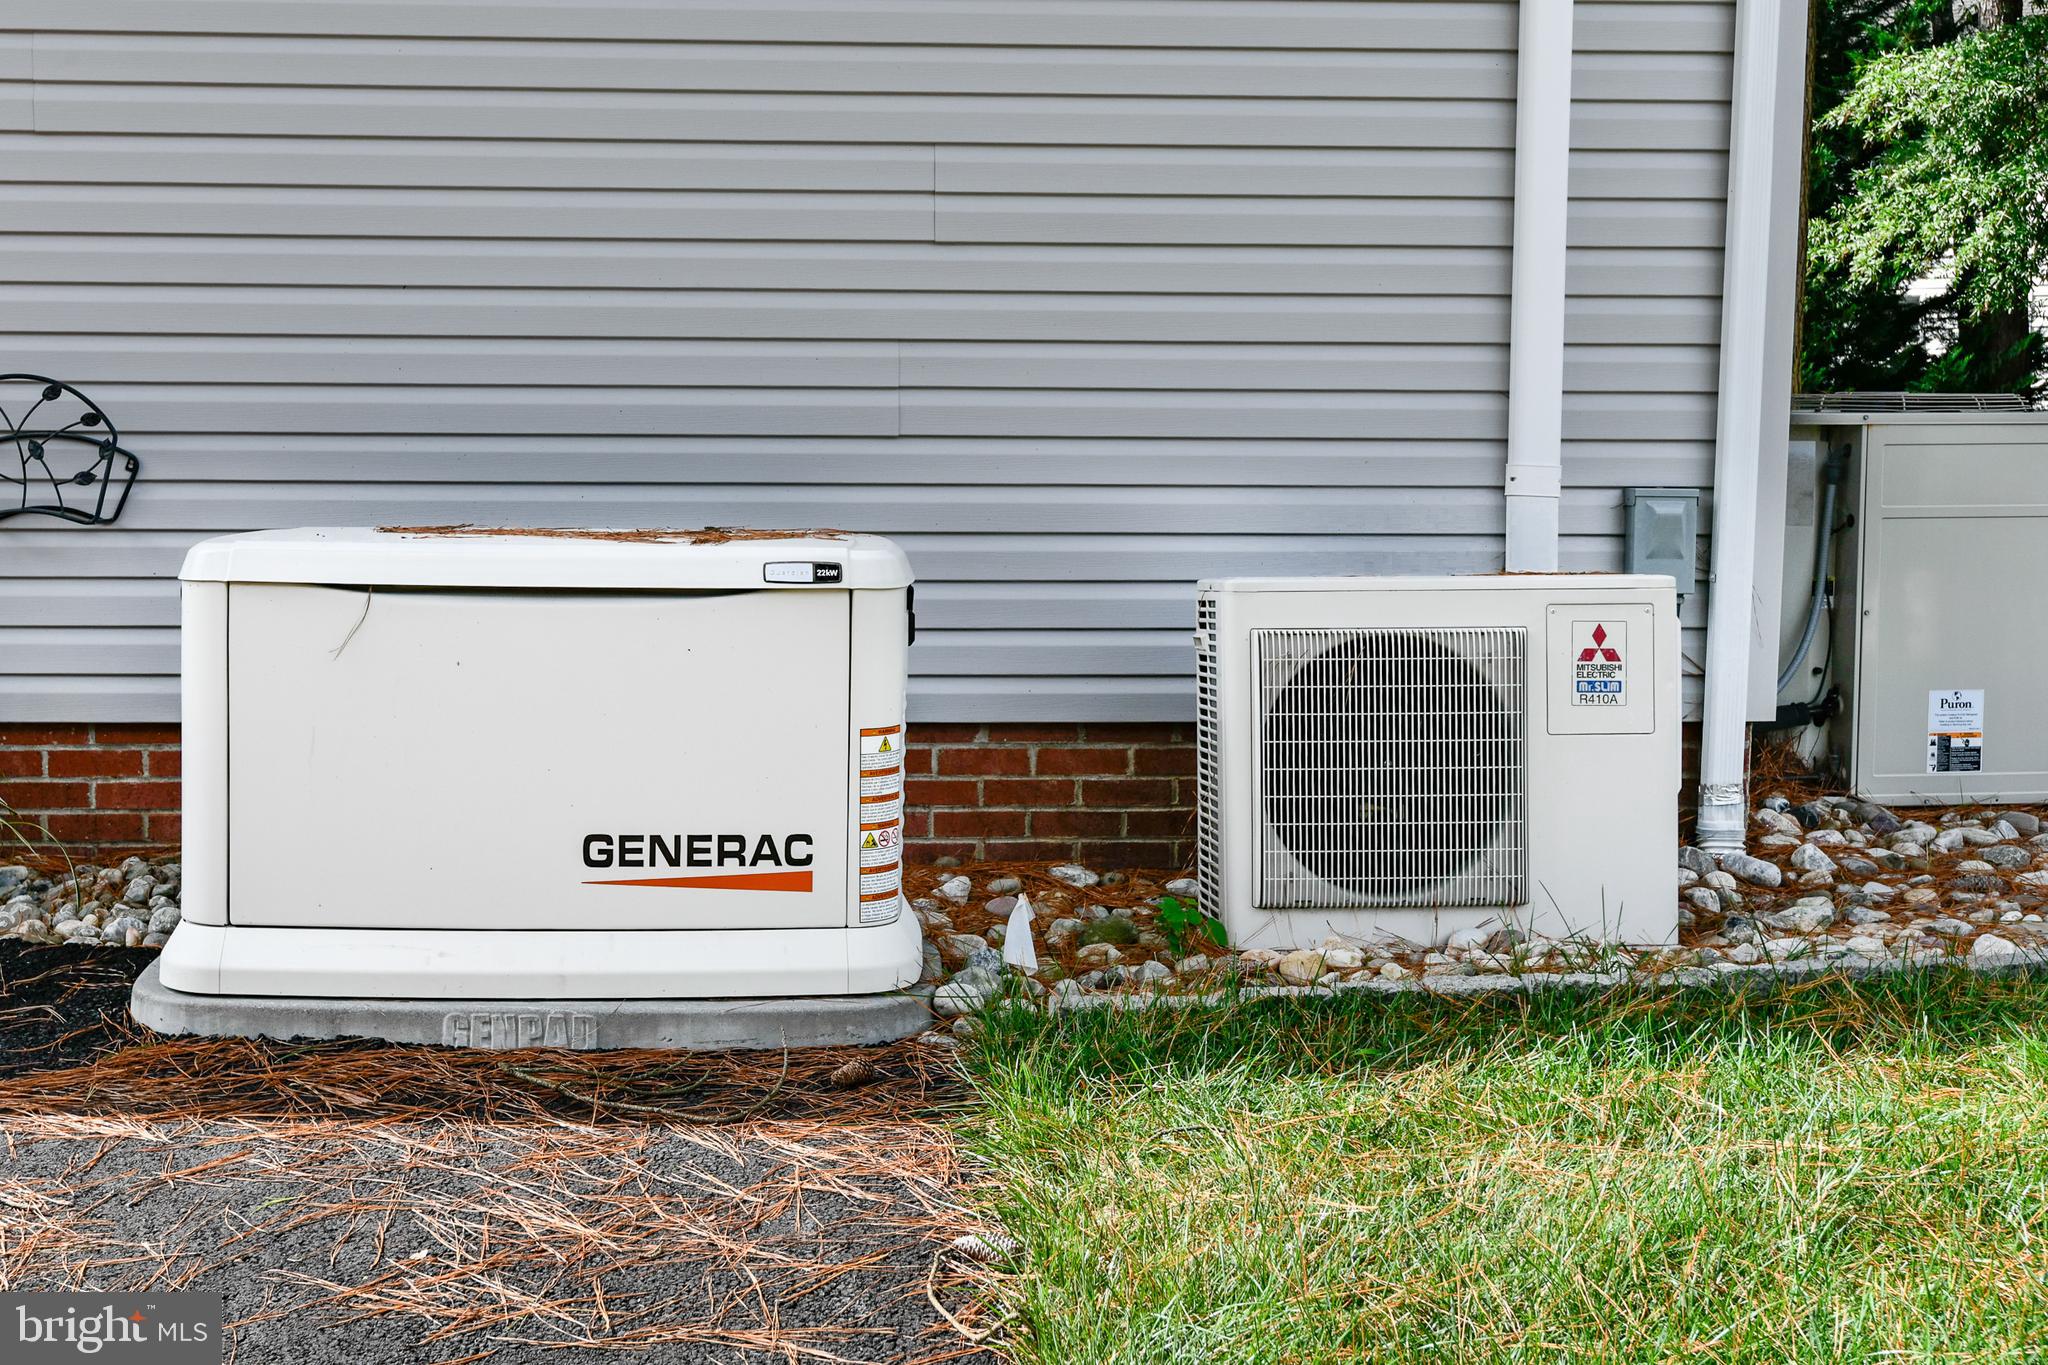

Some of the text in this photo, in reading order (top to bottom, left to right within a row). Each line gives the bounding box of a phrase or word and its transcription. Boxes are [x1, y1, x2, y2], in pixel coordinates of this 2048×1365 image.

[816, 569, 838, 577] 22kW
[1579, 694, 1618, 704] R410A
[1940, 698, 1972, 709] Puron
[582, 834, 813, 868] GENERAC
[442, 1012, 598, 1050] GENPAD
